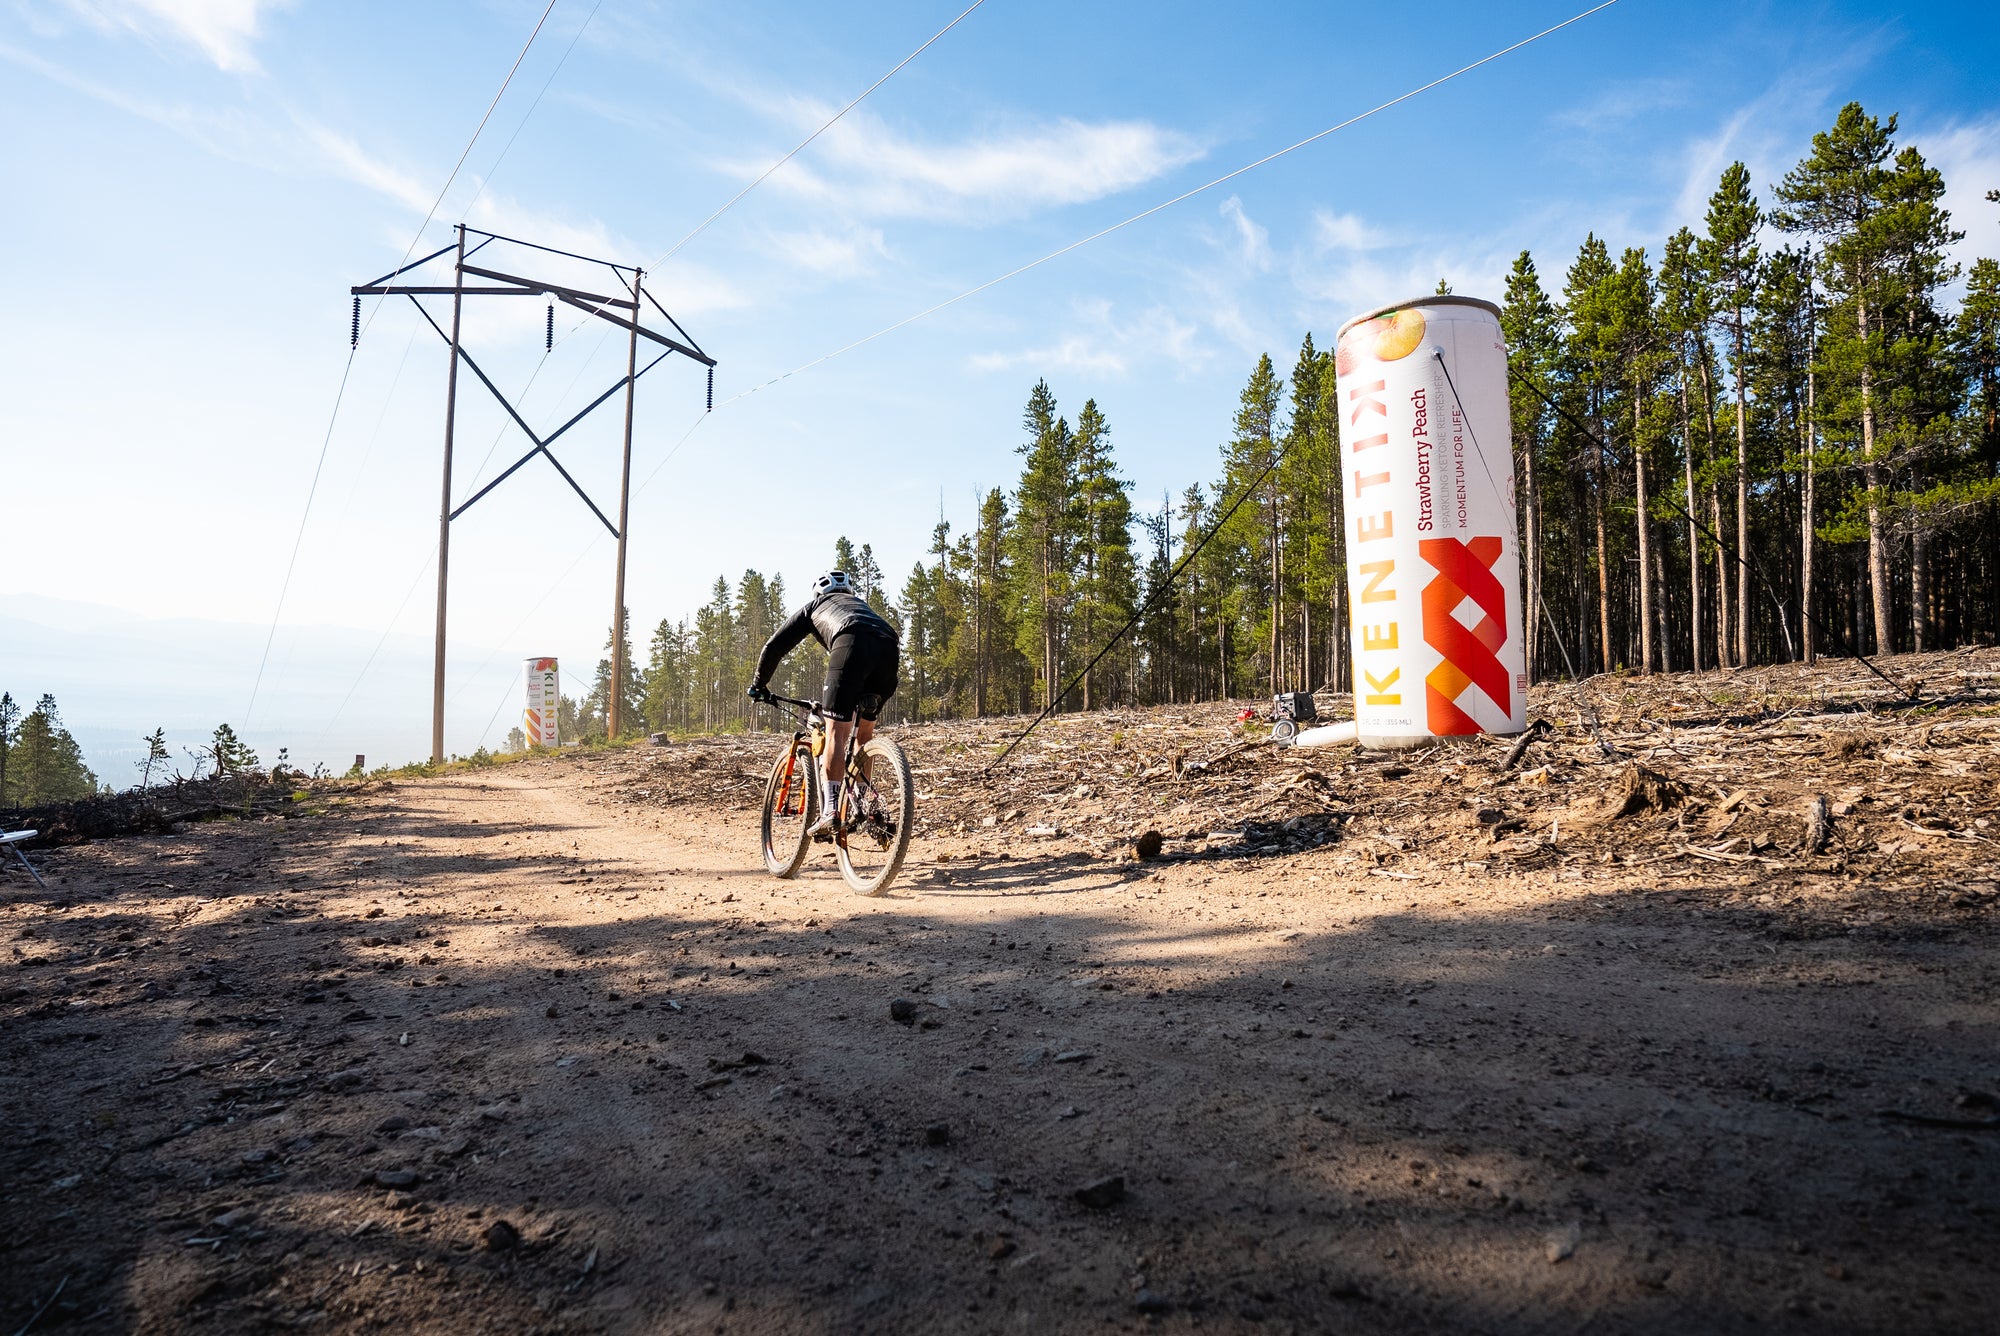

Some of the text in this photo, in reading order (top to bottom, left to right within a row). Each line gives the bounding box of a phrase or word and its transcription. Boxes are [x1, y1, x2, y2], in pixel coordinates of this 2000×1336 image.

[1411, 388, 1433, 531] Strawberry Peach
[1438, 432, 1448, 472] KETONE
[1454, 436, 1464, 457] FOR
[1440, 475, 1452, 529] SPARKLING
[1456, 460, 1467, 528] MOMENTUM
[1350, 380, 1401, 706] KENETIK
[544, 672, 555, 740] KENETIK
